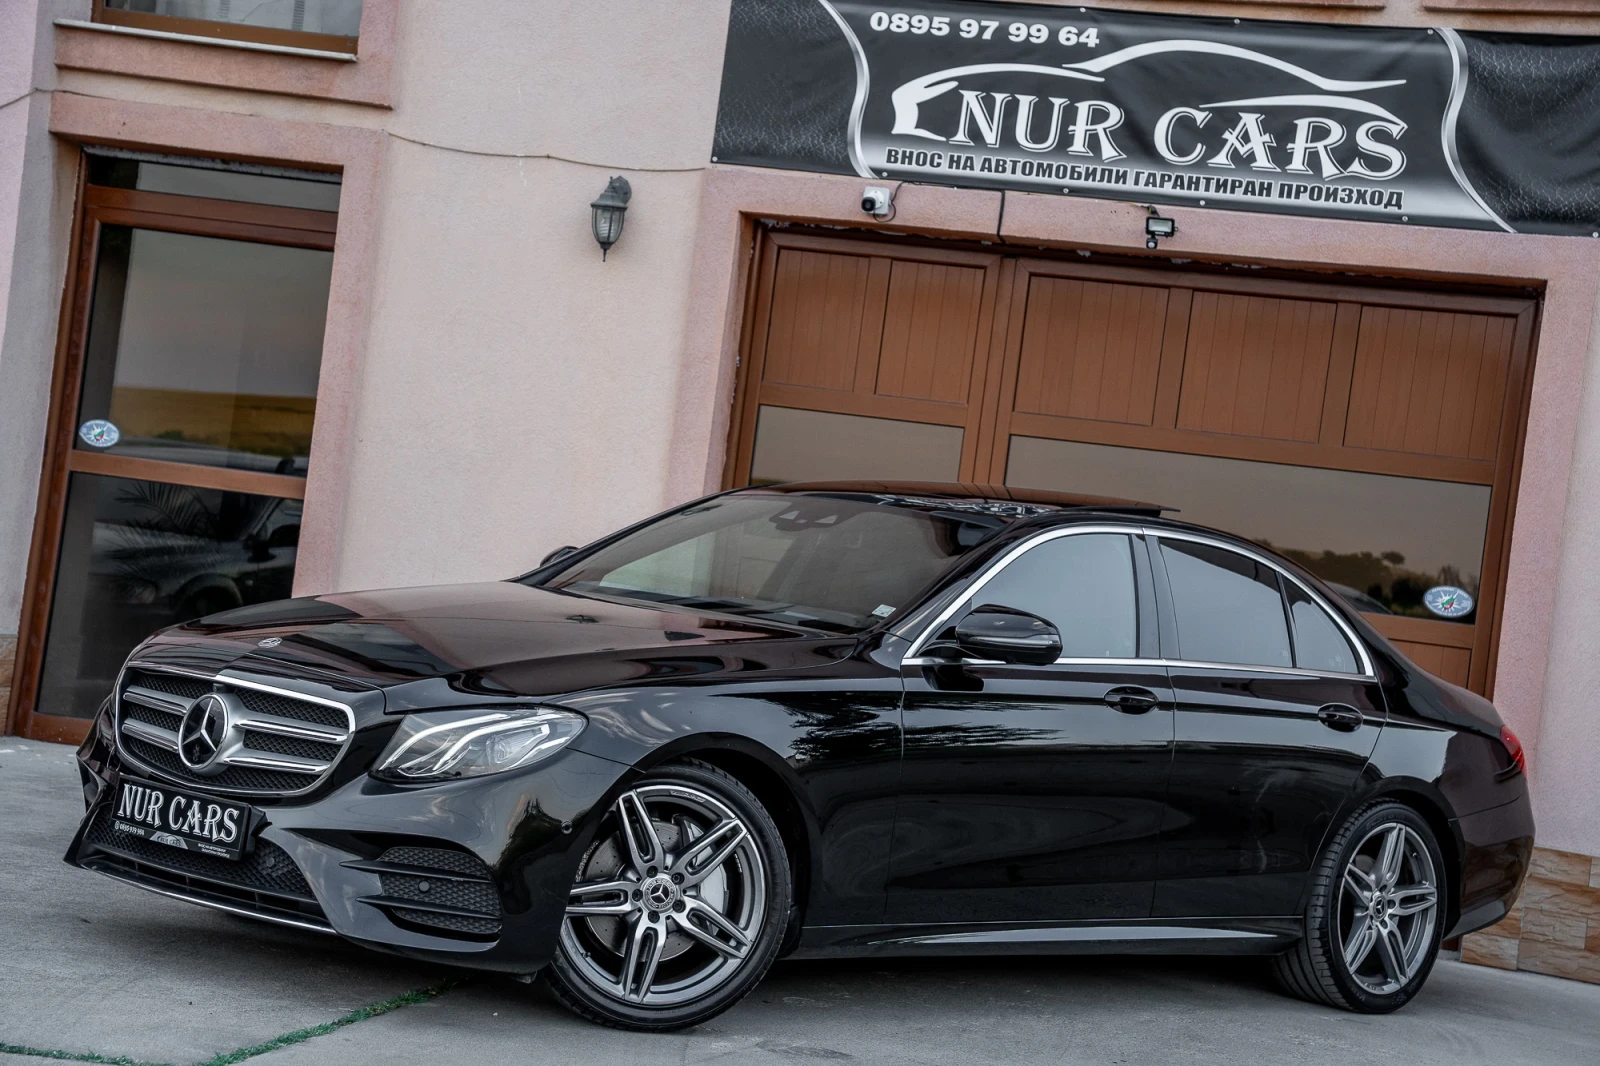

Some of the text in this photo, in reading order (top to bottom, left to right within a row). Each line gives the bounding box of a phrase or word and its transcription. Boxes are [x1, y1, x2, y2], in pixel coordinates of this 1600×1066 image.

[869, 11, 1100, 48] 0895 97 99 64
[949, 89, 1408, 181] NUR CARS
[886, 148, 1405, 210] ВНОС НА АВТОМОБИЛИ ГАРАНТИРАН ПРОИЗХОД
[117, 783, 240, 843] NUR CARS
